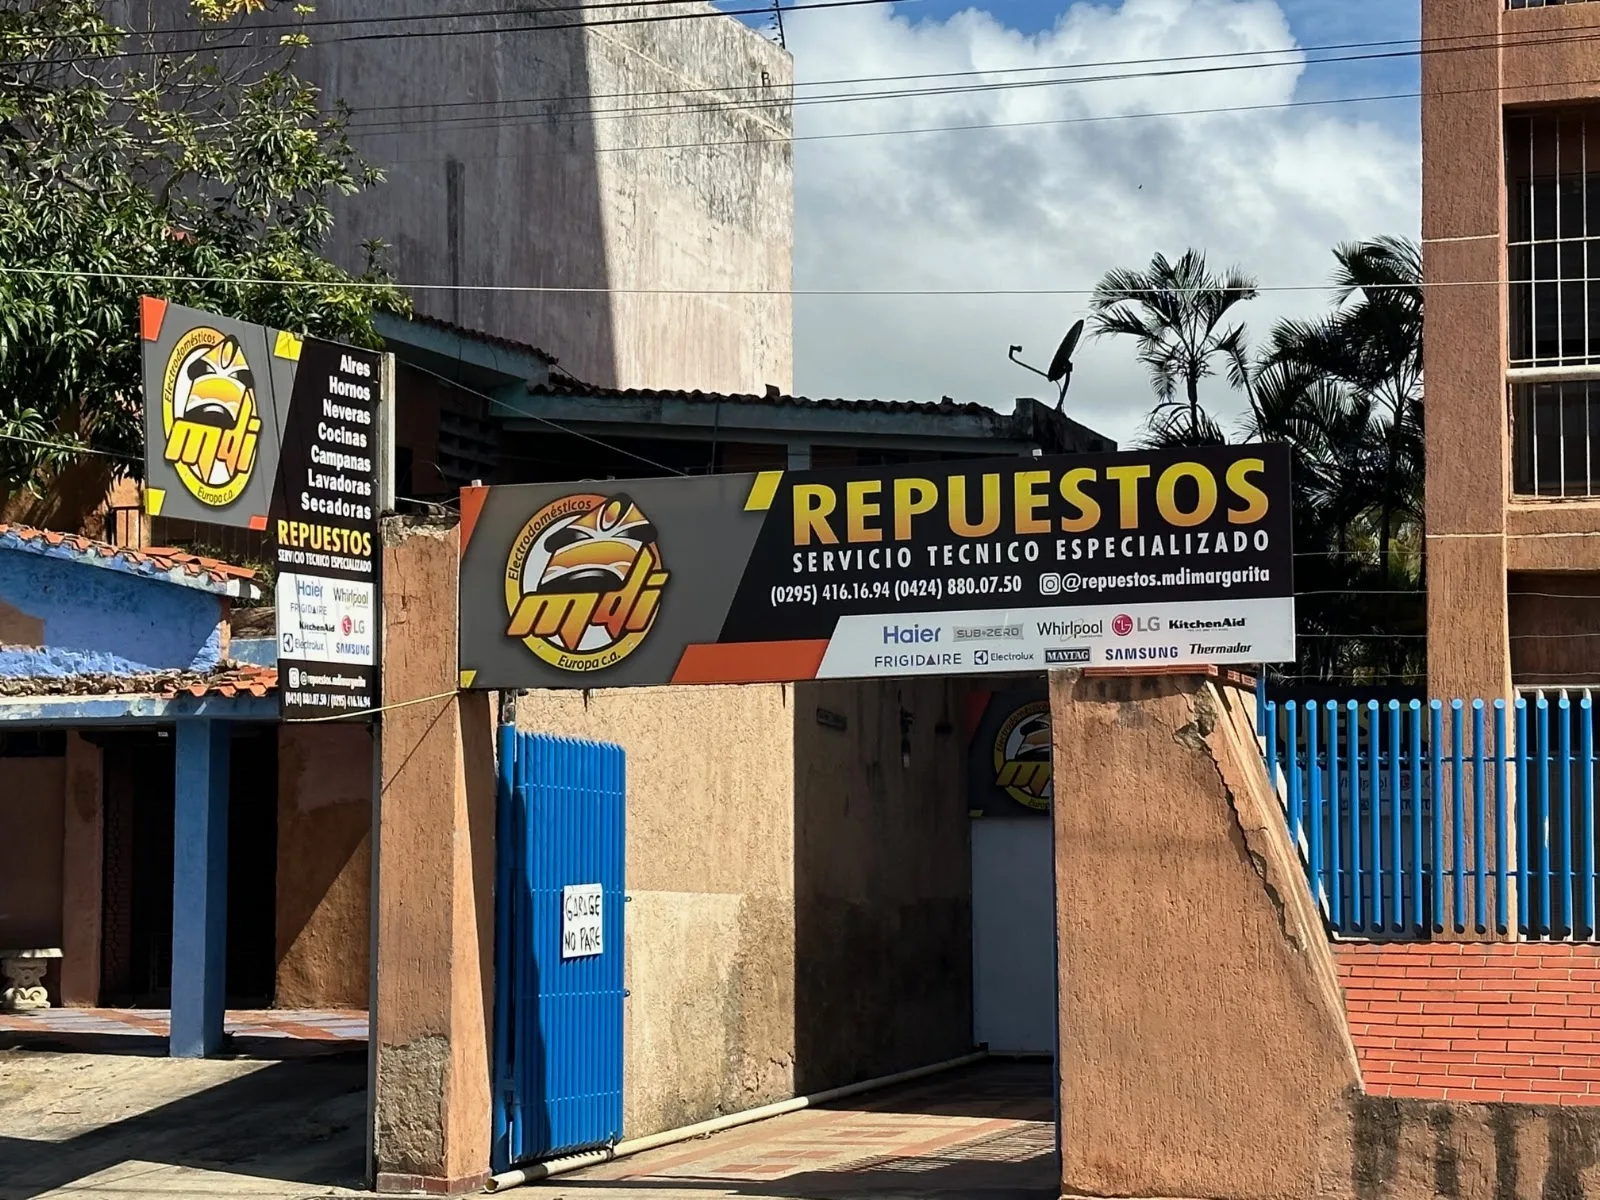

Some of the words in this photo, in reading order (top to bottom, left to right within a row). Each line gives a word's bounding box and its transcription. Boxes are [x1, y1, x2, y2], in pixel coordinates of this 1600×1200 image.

[164, 331, 216, 403] Electrodomésticos
[339, 354, 371, 377] Aires
[328, 375, 371, 401] Hornos
[322, 398, 371, 425] Neveras
[165, 388, 262, 484] mdi
[317, 421, 368, 448] Cocinas
[310, 444, 372, 473] Campanas
[197, 486, 223, 504] Europa
[307, 468, 372, 496] Lavadoras
[300, 491, 372, 520] Secadoras
[792, 458, 1269, 546] REPUESTOS
[277, 519, 372, 557] REPUESTOS
[508, 499, 592, 581] Electrodomésticos
[792, 547, 912, 573] SERVICIO
[927, 541, 1039, 567] TECNICO
[1055, 529, 1269, 561] ESPECIALIZADO
[277, 549, 305, 565] SERVICIO
[305, 552, 330, 568] TECNICO
[297, 579, 323, 598] Haier
[333, 586, 369, 608] Whirlpool
[506, 546, 670, 651] mdi
[770, 583, 818, 607] (0295)
[822, 580, 890, 601] 416.16.94
[894, 578, 943, 601] (0424)
[947, 575, 1023, 596] 880.07.50
[1062, 565, 1270, 593] @repuestos.mdimargarita
[290, 602, 328, 616] FRIGIDAIRE
[299, 621, 336, 633] KitchenAid
[353, 619, 365, 634] LG
[883, 624, 942, 644] Haier
[1036, 619, 1103, 639] Whirlpool
[1136, 616, 1161, 632] LG
[1168, 617, 1246, 630] KitchenAid
[294, 638, 325, 651] Electrolux
[335, 642, 370, 656] SAMSUNG
[557, 654, 600, 671] Europa
[601, 651, 621, 666] c.a.
[874, 653, 963, 668] FRIGIDAIRE
[990, 651, 1035, 662] Electrolux
[1046, 650, 1089, 661] MAYTAG
[1105, 646, 1179, 661] SAMSUNG
[1189, 642, 1252, 655] Thermador
[564, 930, 576, 951] NO
[580, 926, 601, 952] PARE
